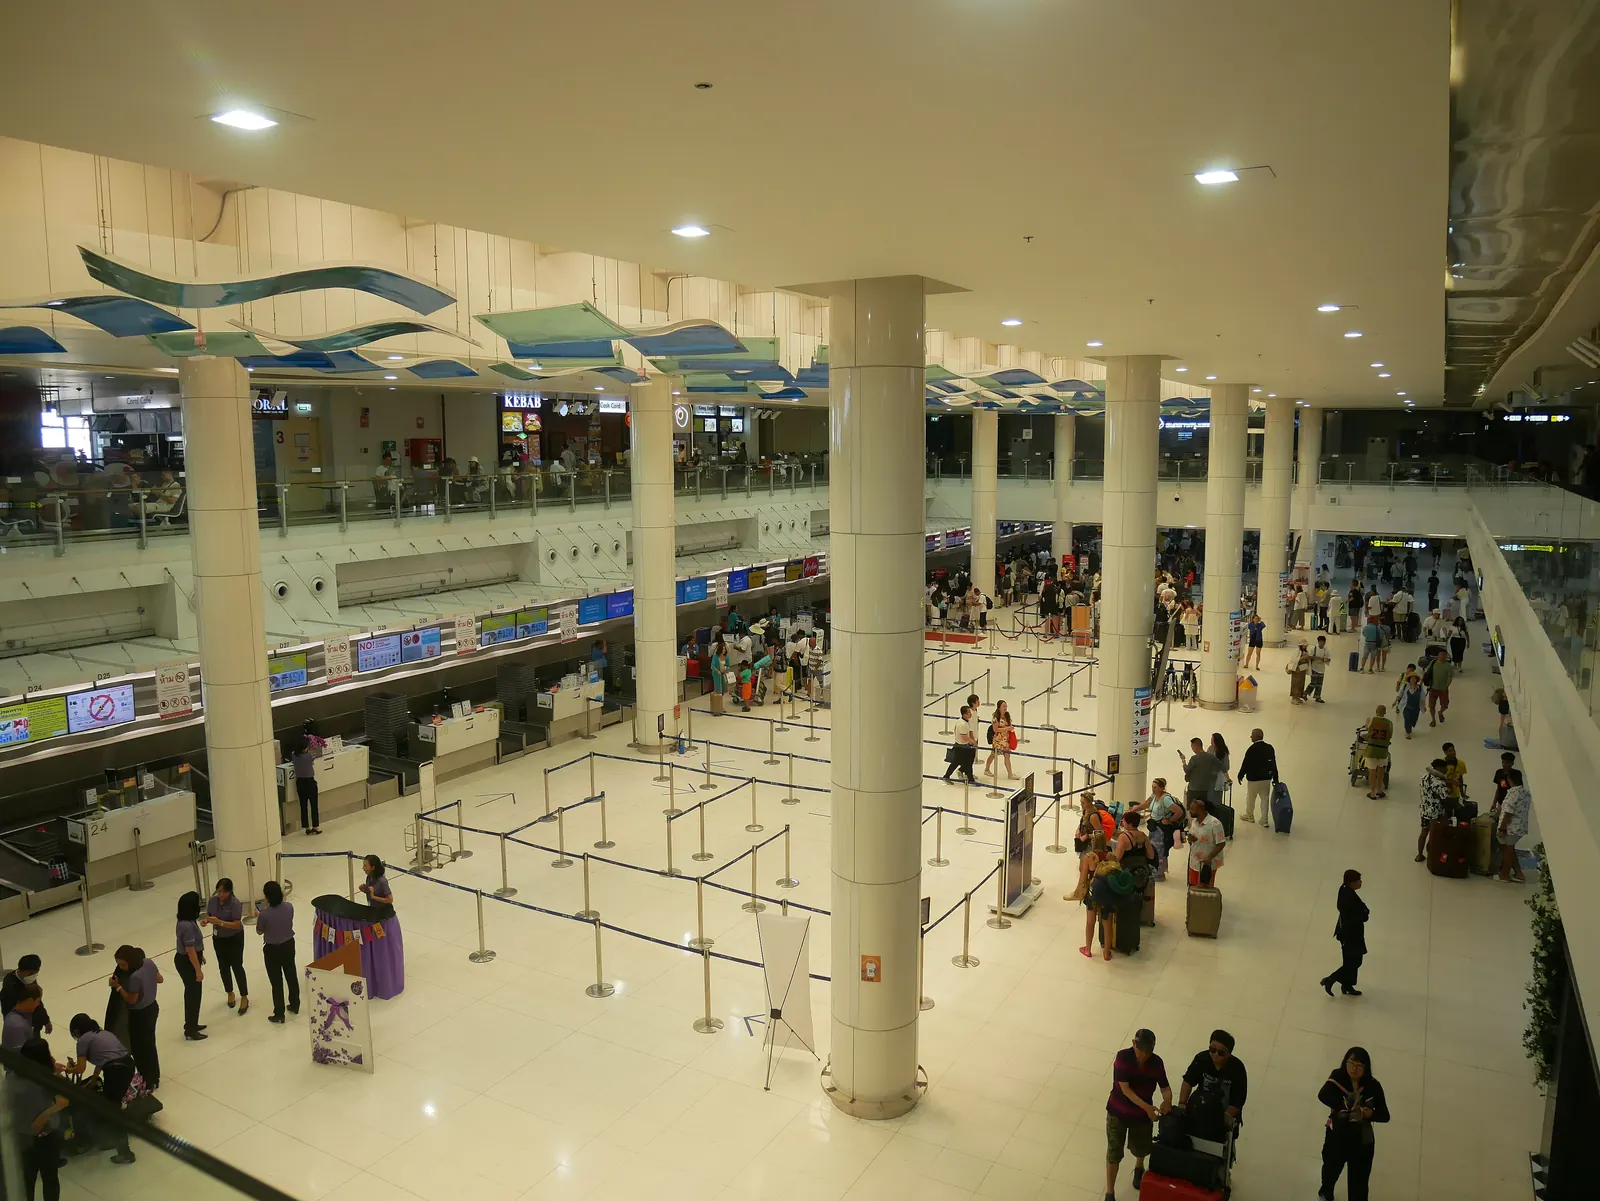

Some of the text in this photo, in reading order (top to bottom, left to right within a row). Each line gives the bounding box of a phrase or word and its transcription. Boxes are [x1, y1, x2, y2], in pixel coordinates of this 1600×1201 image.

[504, 395, 541, 408] KEBAB
[276, 431, 284, 444] 3
[359, 641, 375, 650] NO!
[28, 683, 43, 693] D24
[488, 713, 498, 722] 29
[1371, 728, 1388, 740] 23
[91, 822, 109, 837] 24
